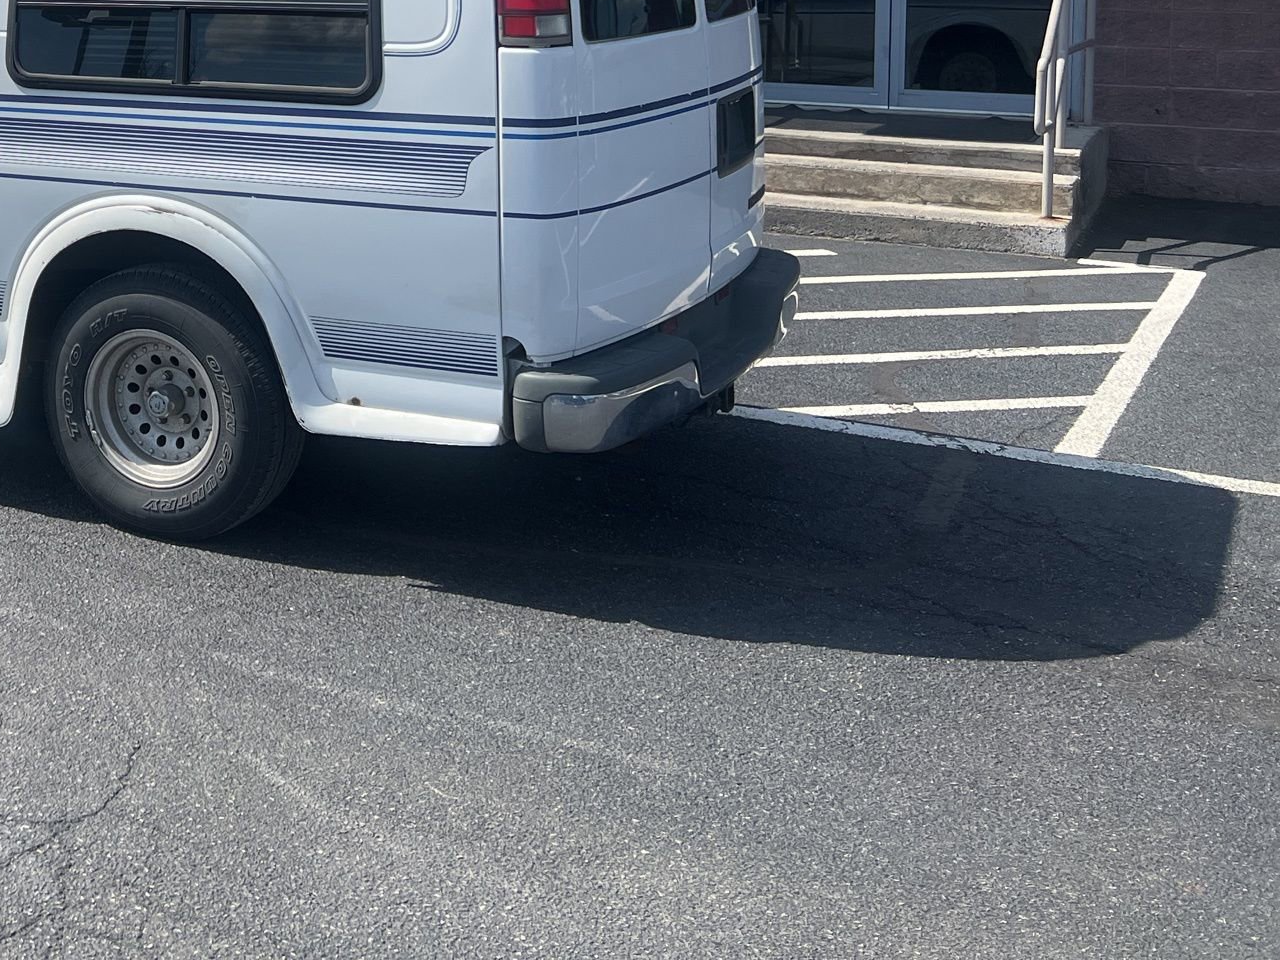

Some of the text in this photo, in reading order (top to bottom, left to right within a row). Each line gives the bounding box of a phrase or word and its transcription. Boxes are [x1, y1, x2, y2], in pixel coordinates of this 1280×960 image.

[63, 343, 82, 440] TOYO
[142, 355, 236, 514] OPEN COUNTRY
